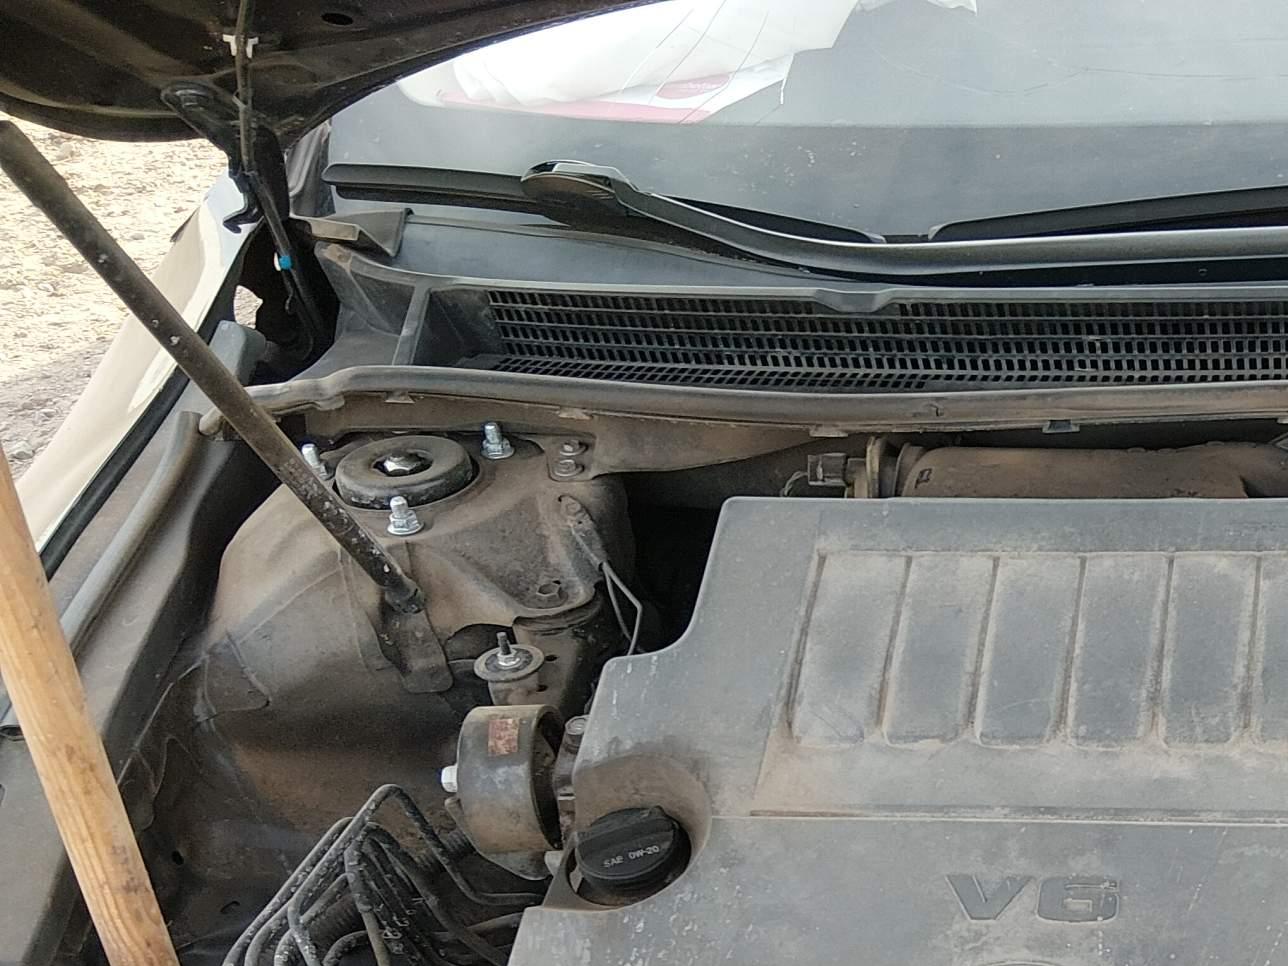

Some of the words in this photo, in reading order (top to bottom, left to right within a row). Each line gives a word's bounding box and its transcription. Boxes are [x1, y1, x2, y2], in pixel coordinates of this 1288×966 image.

[602, 855, 624, 868] SAE
[628, 845, 660, 860] 0W-20
[944, 874, 1120, 924] V6
